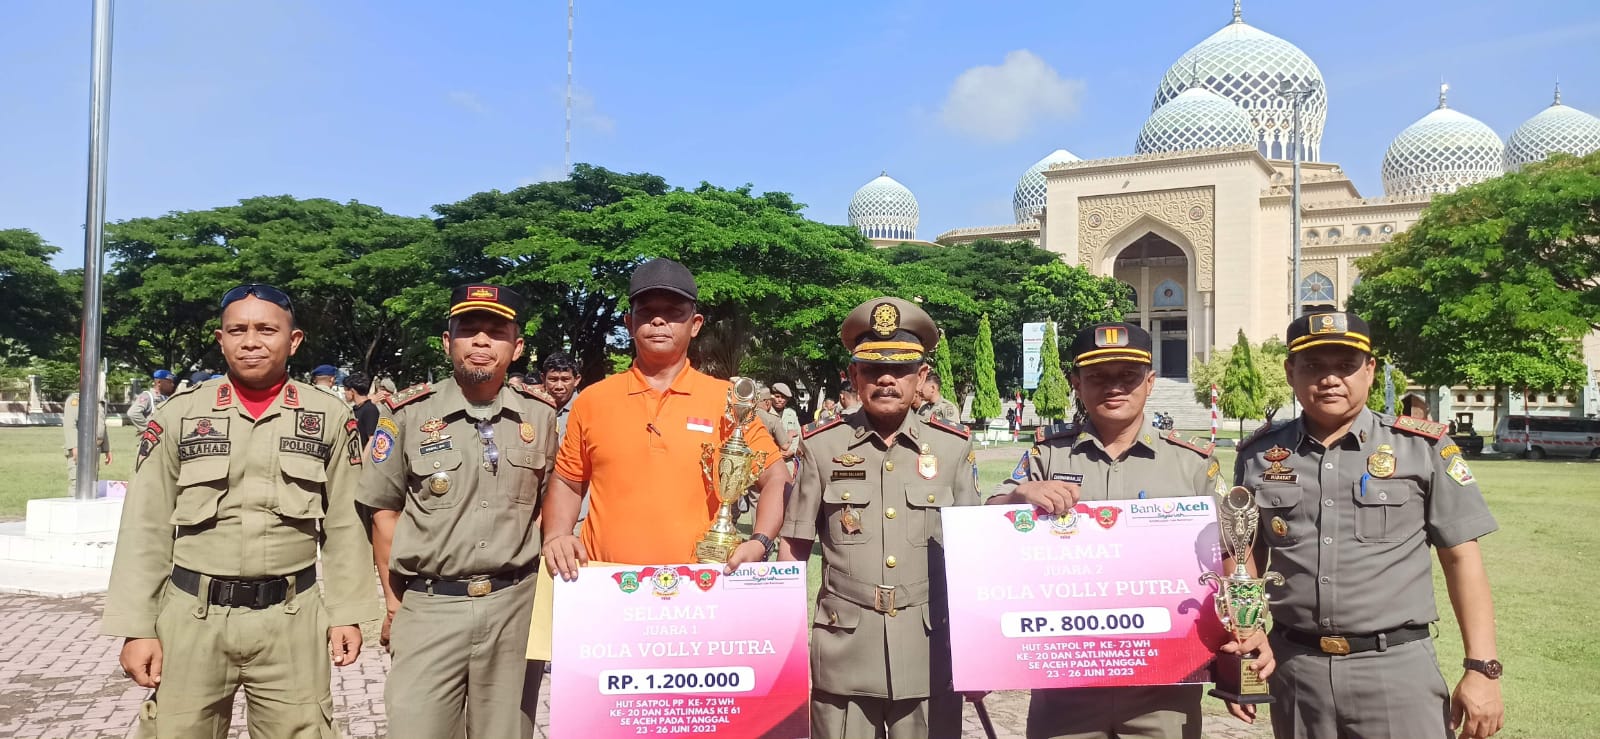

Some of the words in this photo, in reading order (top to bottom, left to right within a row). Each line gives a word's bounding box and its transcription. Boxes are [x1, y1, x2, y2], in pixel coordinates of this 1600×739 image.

[181, 443, 228, 458] S.KAHAR
[1130, 503, 1162, 514] Bank
[1176, 501, 1209, 512] Aceh
[1021, 543, 1123, 561] SELAMAT
[769, 565, 800, 575] Aceh
[1043, 565, 1092, 577] JUARA
[1095, 563, 1104, 575] 2
[976, 583, 1035, 601] BOLA
[1039, 580, 1109, 599] VOLLY
[1115, 578, 1191, 597] PUTRA
[623, 604, 719, 621] SELAMAT
[1020, 617, 1054, 633] RP.
[1061, 613, 1145, 632] 800.000
[643, 625, 688, 636] JUARA
[690, 624, 698, 635] 1
[579, 642, 633, 658] BOLA
[637, 641, 703, 657] VOLLY
[707, 639, 776, 656] PUTRA
[1022, 643, 1040, 652] HUT
[1043, 641, 1081, 651] SATPOL
[1082, 641, 1096, 650] PP
[1100, 640, 1117, 649] KE-
[1118, 639, 1132, 649] 73
[1132, 639, 1151, 648] WH
[1016, 652, 1033, 661] KE-
[1035, 652, 1049, 660] 20
[1050, 651, 1073, 660] DAN
[1074, 649, 1131, 659] SATLINMAS
[1132, 648, 1147, 657] KE
[1147, 647, 1159, 657] 61
[1028, 661, 1040, 670] SE
[1041, 660, 1069, 669] ACEH
[1070, 659, 1098, 668] PADA
[1100, 658, 1148, 667] TANGGAL
[1046, 670, 1060, 678] 23
[1068, 669, 1081, 678] 26
[1082, 668, 1105, 677] JUNI
[1107, 667, 1134, 676] 2023
[607, 675, 639, 690] RP.
[645, 672, 740, 689] 1.200.000
[616, 700, 634, 708] HUT
[635, 699, 671, 708] SATPOL
[672, 699, 684, 707] PP
[688, 698, 704, 707] KE-
[705, 698, 717, 706] 73
[718, 698, 735, 706] WH
[609, 709, 626, 717] KE-
[627, 709, 640, 717] 20
[641, 708, 662, 717] DAN
[663, 707, 715, 716] SATLINMAS
[717, 707, 729, 715] KE
[730, 706, 741, 714] 61
[620, 717, 631, 726] SE
[632, 717, 657, 725] ACEH
[659, 716, 685, 725] PADA
[686, 715, 731, 724] TANGGAL
[635, 726, 648, 734] 23
[655, 726, 669, 734] 26
[669, 725, 690, 734] JUNI
[692, 724, 717, 733] 2023
